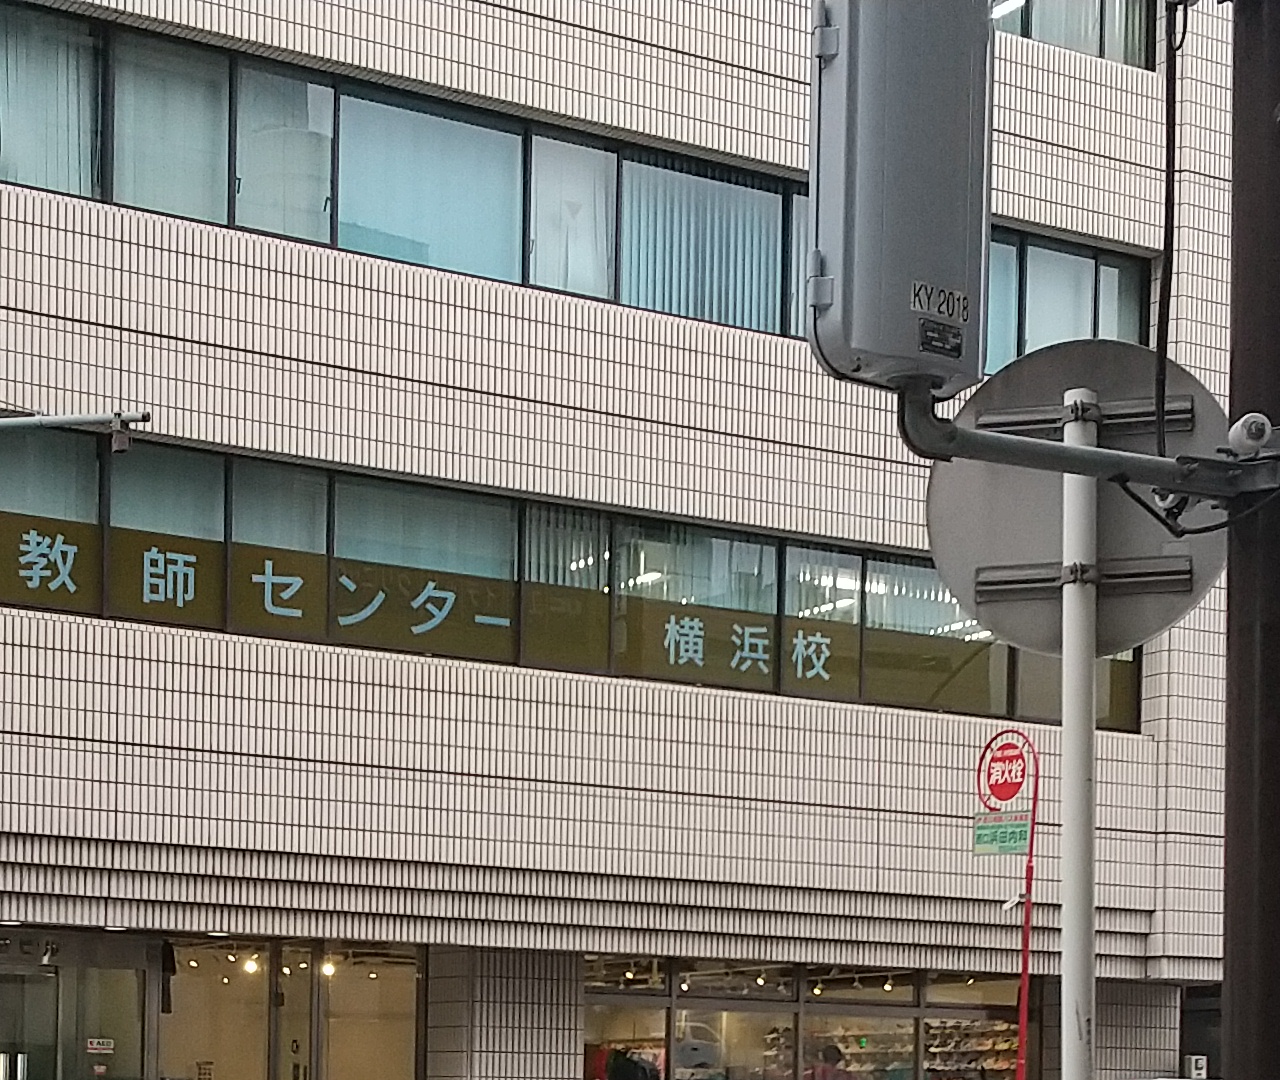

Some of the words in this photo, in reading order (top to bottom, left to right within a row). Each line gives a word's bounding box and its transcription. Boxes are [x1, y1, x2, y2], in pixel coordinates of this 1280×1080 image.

[913, 282, 934, 311] KY
[937, 288, 969, 323] 2018
[663, 613, 832, 682] 横浜校
[988, 758, 1025, 785] 消火栓
